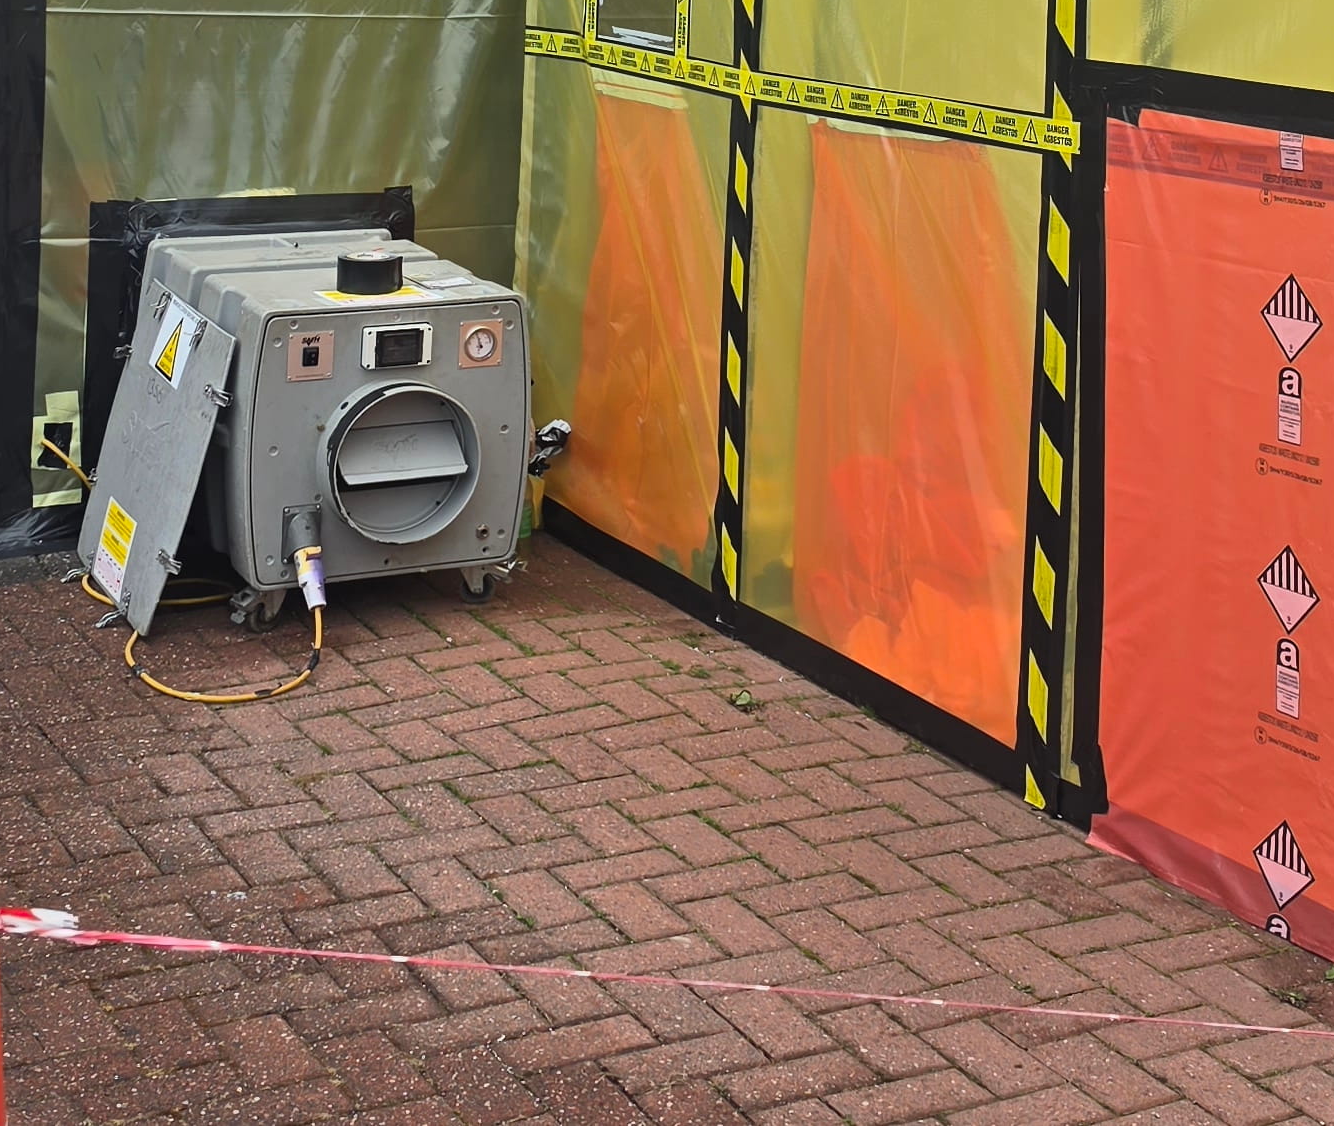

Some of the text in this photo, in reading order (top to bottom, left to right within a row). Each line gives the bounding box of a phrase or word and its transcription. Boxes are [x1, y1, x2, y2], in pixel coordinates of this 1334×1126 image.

[1046, 124, 1070, 136] DANGER
[1043, 135, 1073, 146] ASBESTOS
[1282, 369, 1299, 396] a
[1280, 641, 1297, 669] a
